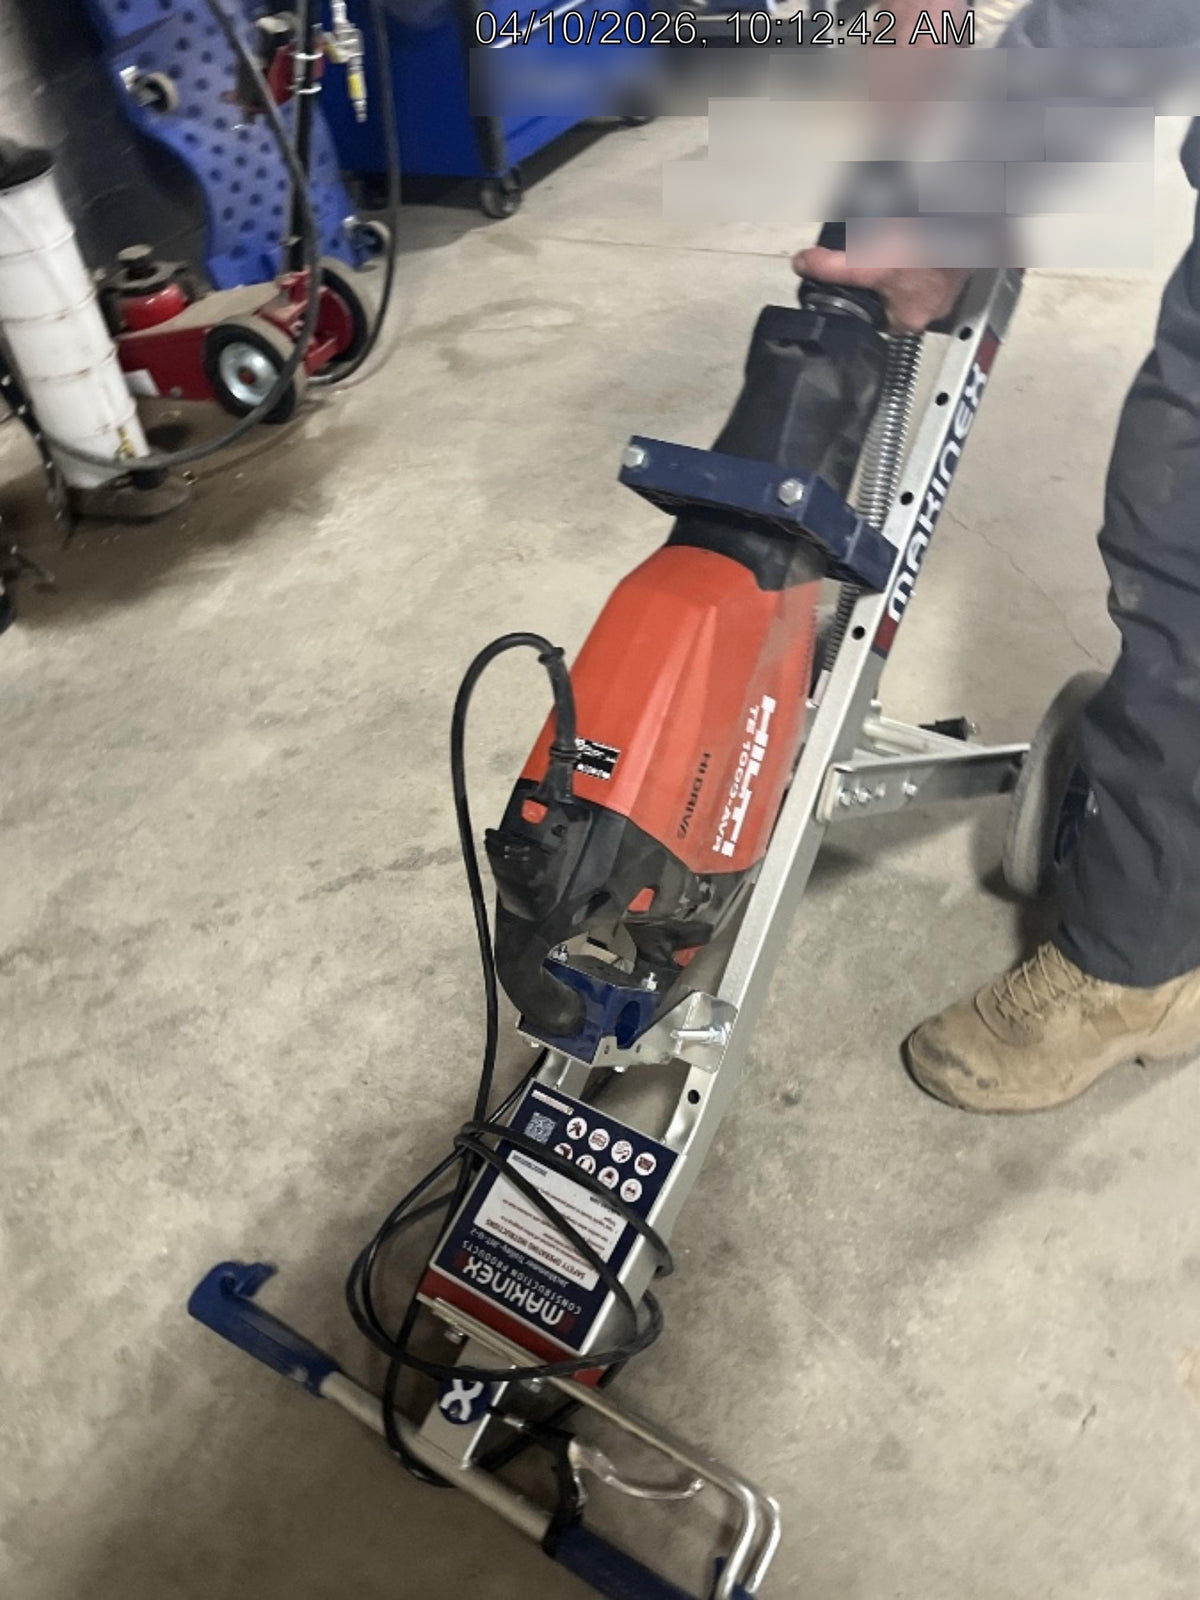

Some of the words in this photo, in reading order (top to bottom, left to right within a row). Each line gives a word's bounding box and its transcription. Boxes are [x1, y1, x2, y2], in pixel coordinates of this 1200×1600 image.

[884, 360, 989, 623] MAKINEX
[744, 705, 760, 735] TE
[719, 694, 776, 858] HILTI
[484, 1217, 529, 1247] INSTRUCTIONS
[460, 1238, 510, 1272] PRODUCTS
[526, 1239, 563, 1266] OPERATING
[560, 1259, 586, 1280] SAFETY
[460, 1253, 565, 1328] MAKINEX
[508, 1267, 582, 1315] CONSTRUCTION
